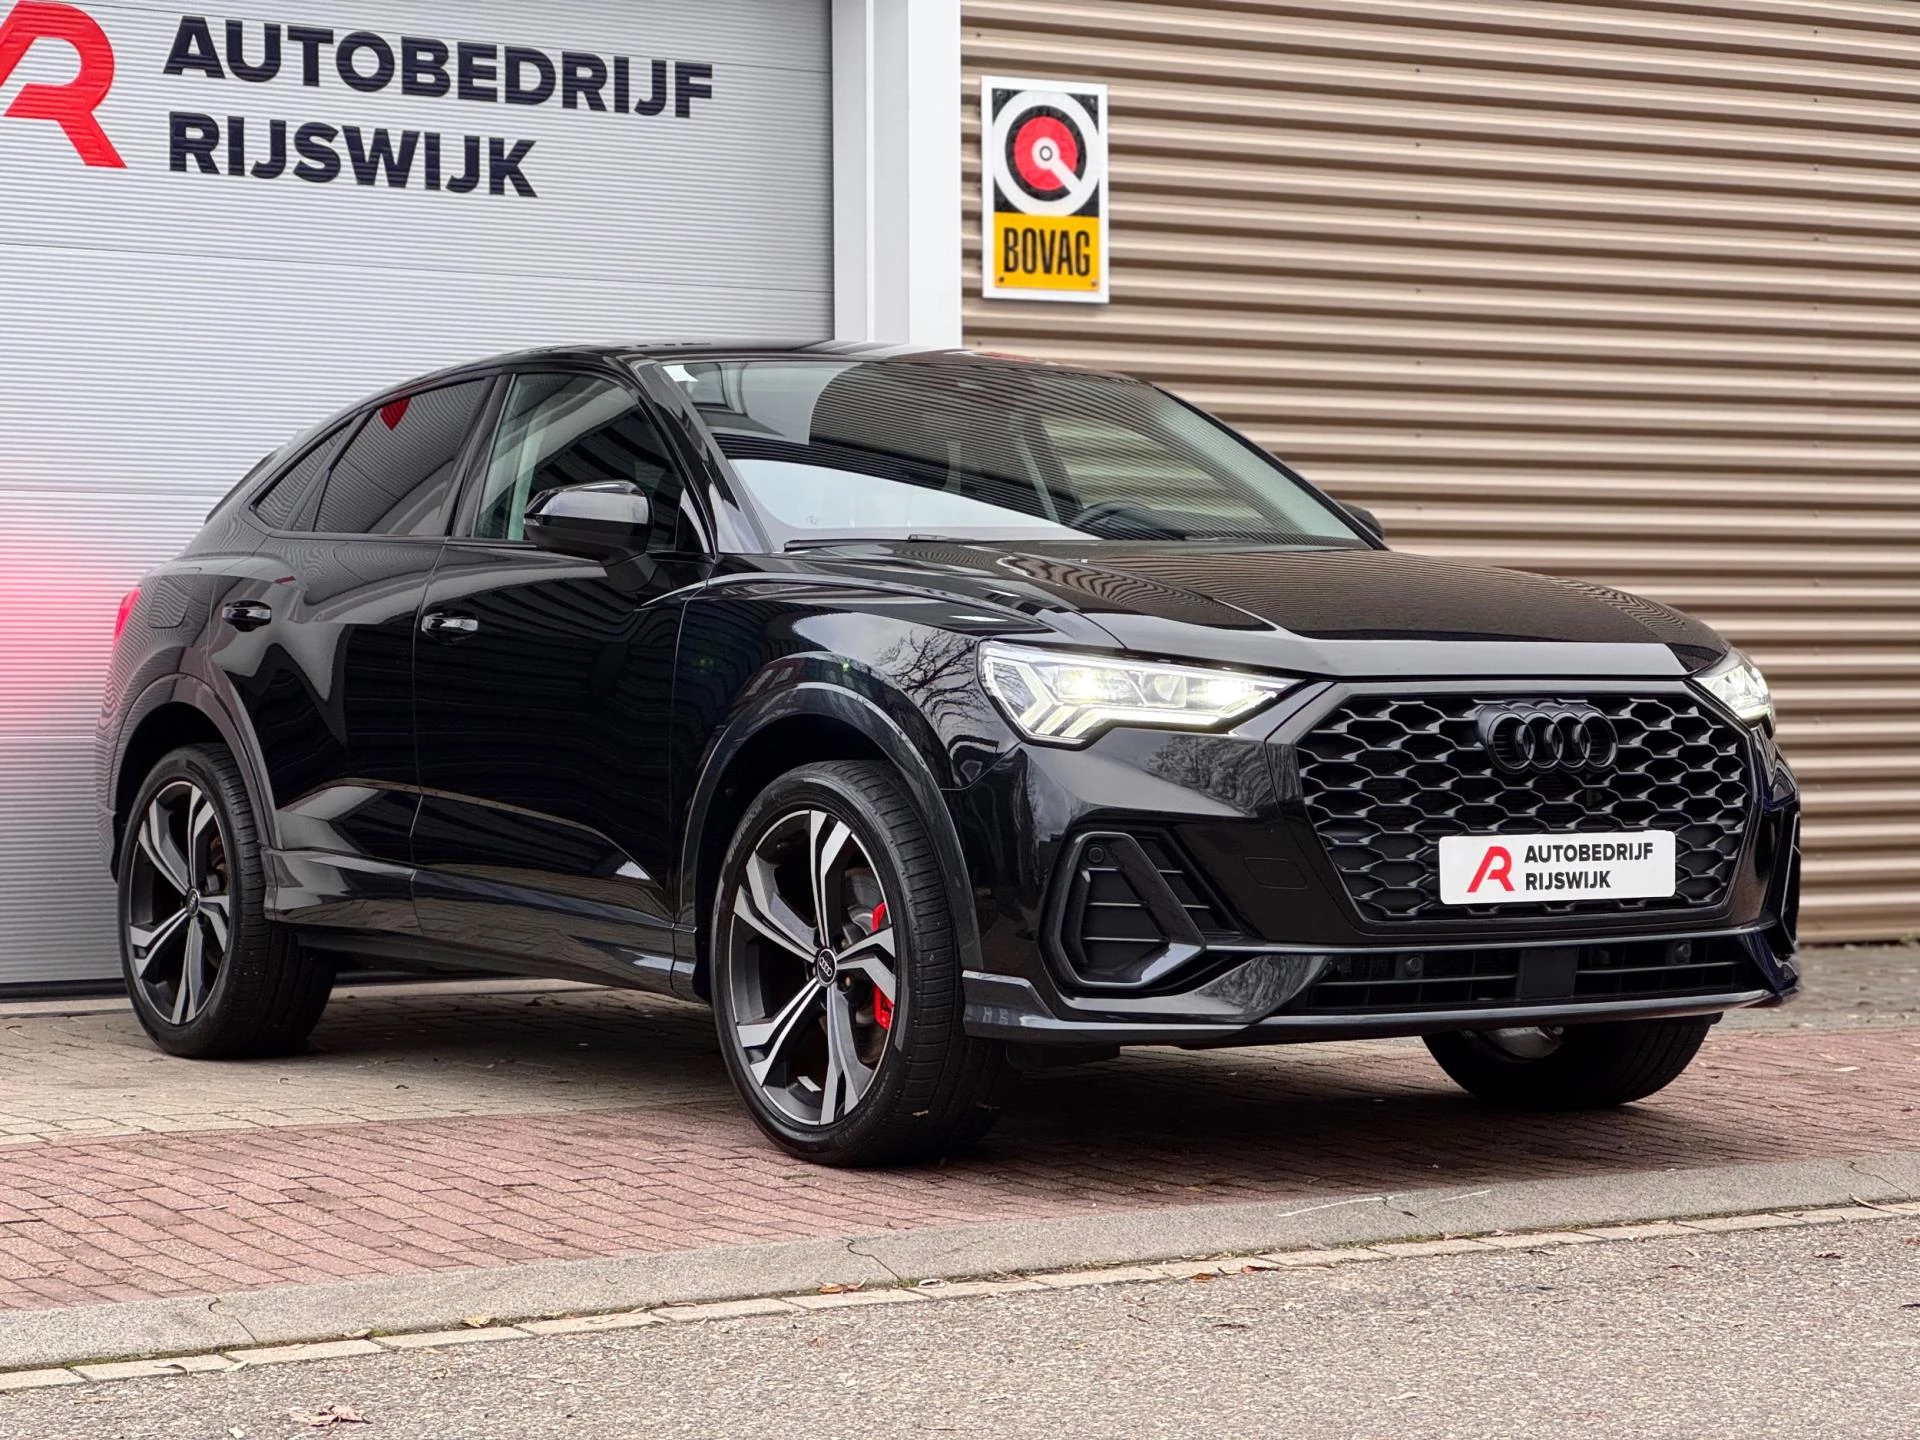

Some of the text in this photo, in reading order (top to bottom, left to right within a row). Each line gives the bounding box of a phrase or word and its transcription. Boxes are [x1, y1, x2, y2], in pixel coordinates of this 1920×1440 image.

[162, 15, 713, 119] AUTOBEDRIJF
[169, 111, 538, 198] RIJSWIJK
[1003, 226, 1091, 277] BOVAG
[1524, 842, 1653, 864] AUTOBEDRIJF
[1525, 870, 1612, 891] RIJSWIJK
